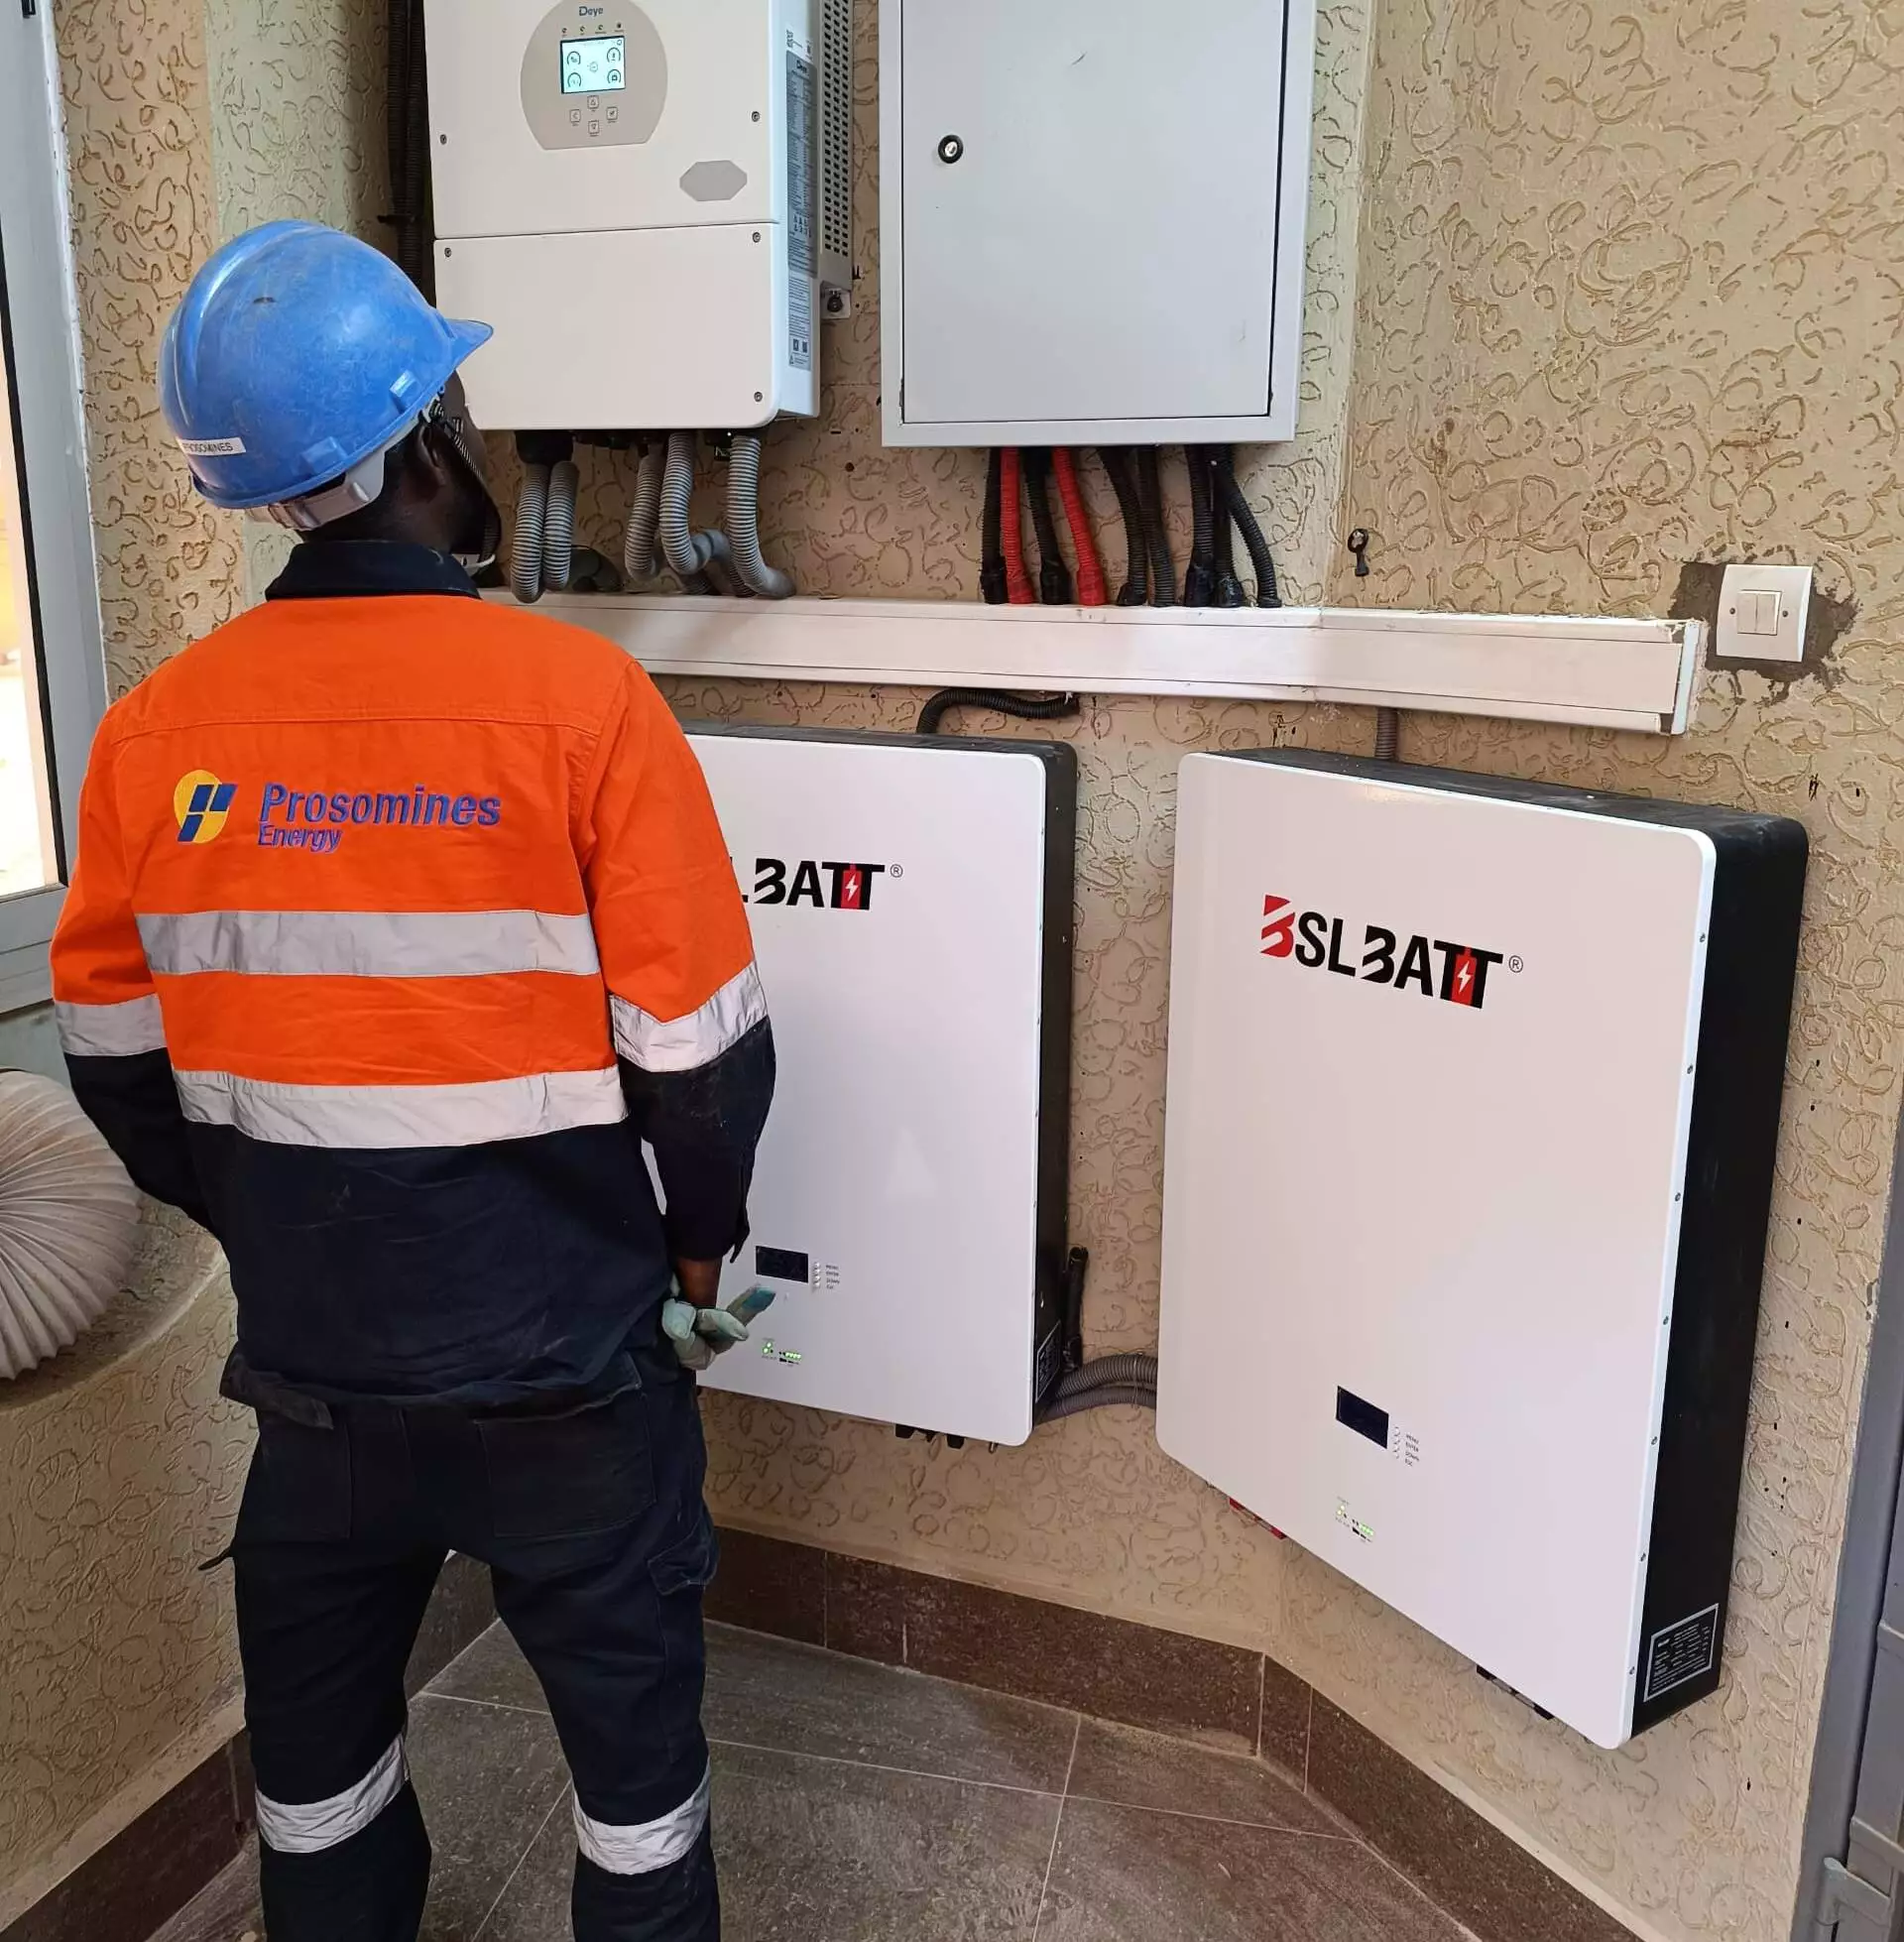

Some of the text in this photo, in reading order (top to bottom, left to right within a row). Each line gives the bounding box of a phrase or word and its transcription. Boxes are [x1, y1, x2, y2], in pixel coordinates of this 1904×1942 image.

[578, 5, 604, 18] Deye
[259, 784, 501, 825] Prosomines
[258, 824, 342, 853] Energy
